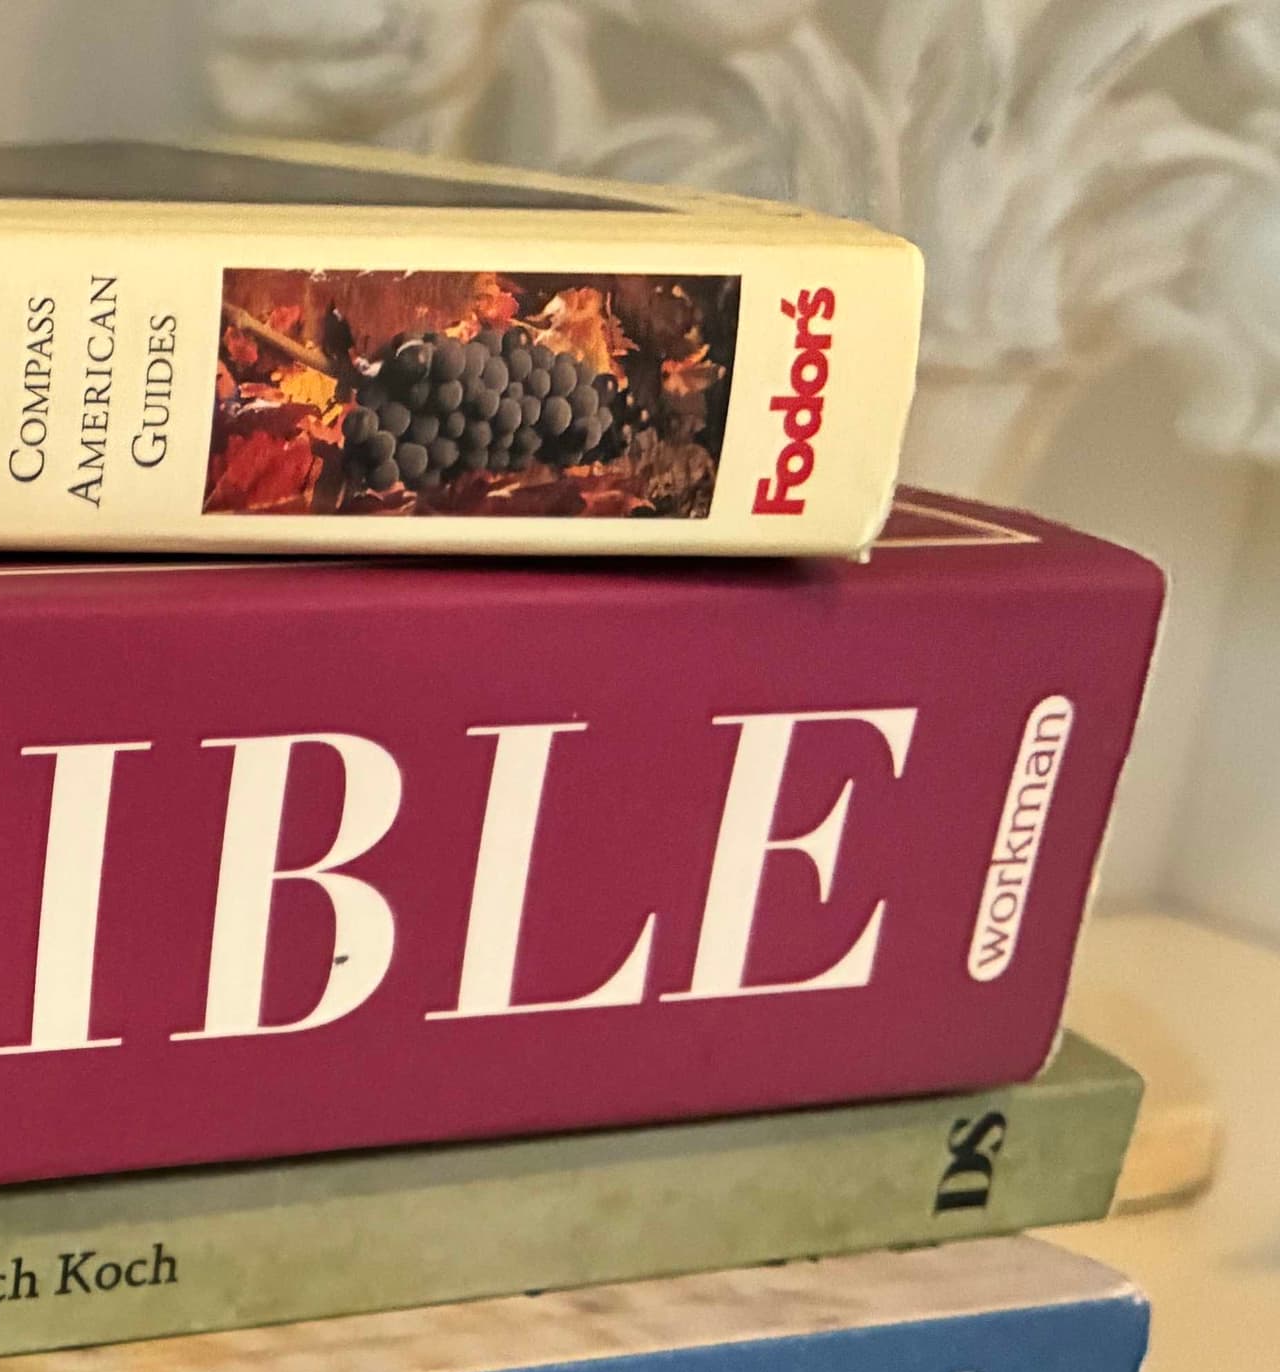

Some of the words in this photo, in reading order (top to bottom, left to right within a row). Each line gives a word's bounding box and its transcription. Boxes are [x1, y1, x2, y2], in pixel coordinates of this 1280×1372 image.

[7, 295, 58, 485] COMPASS
[69, 272, 121, 509] AMERICAN
[130, 310, 180, 471] GUIDES
[752, 286, 836, 516] Fodor's
[977, 707, 1069, 969] workman
[934, 1110, 1008, 1218] DS
[53, 1242, 180, 1296] Koch
